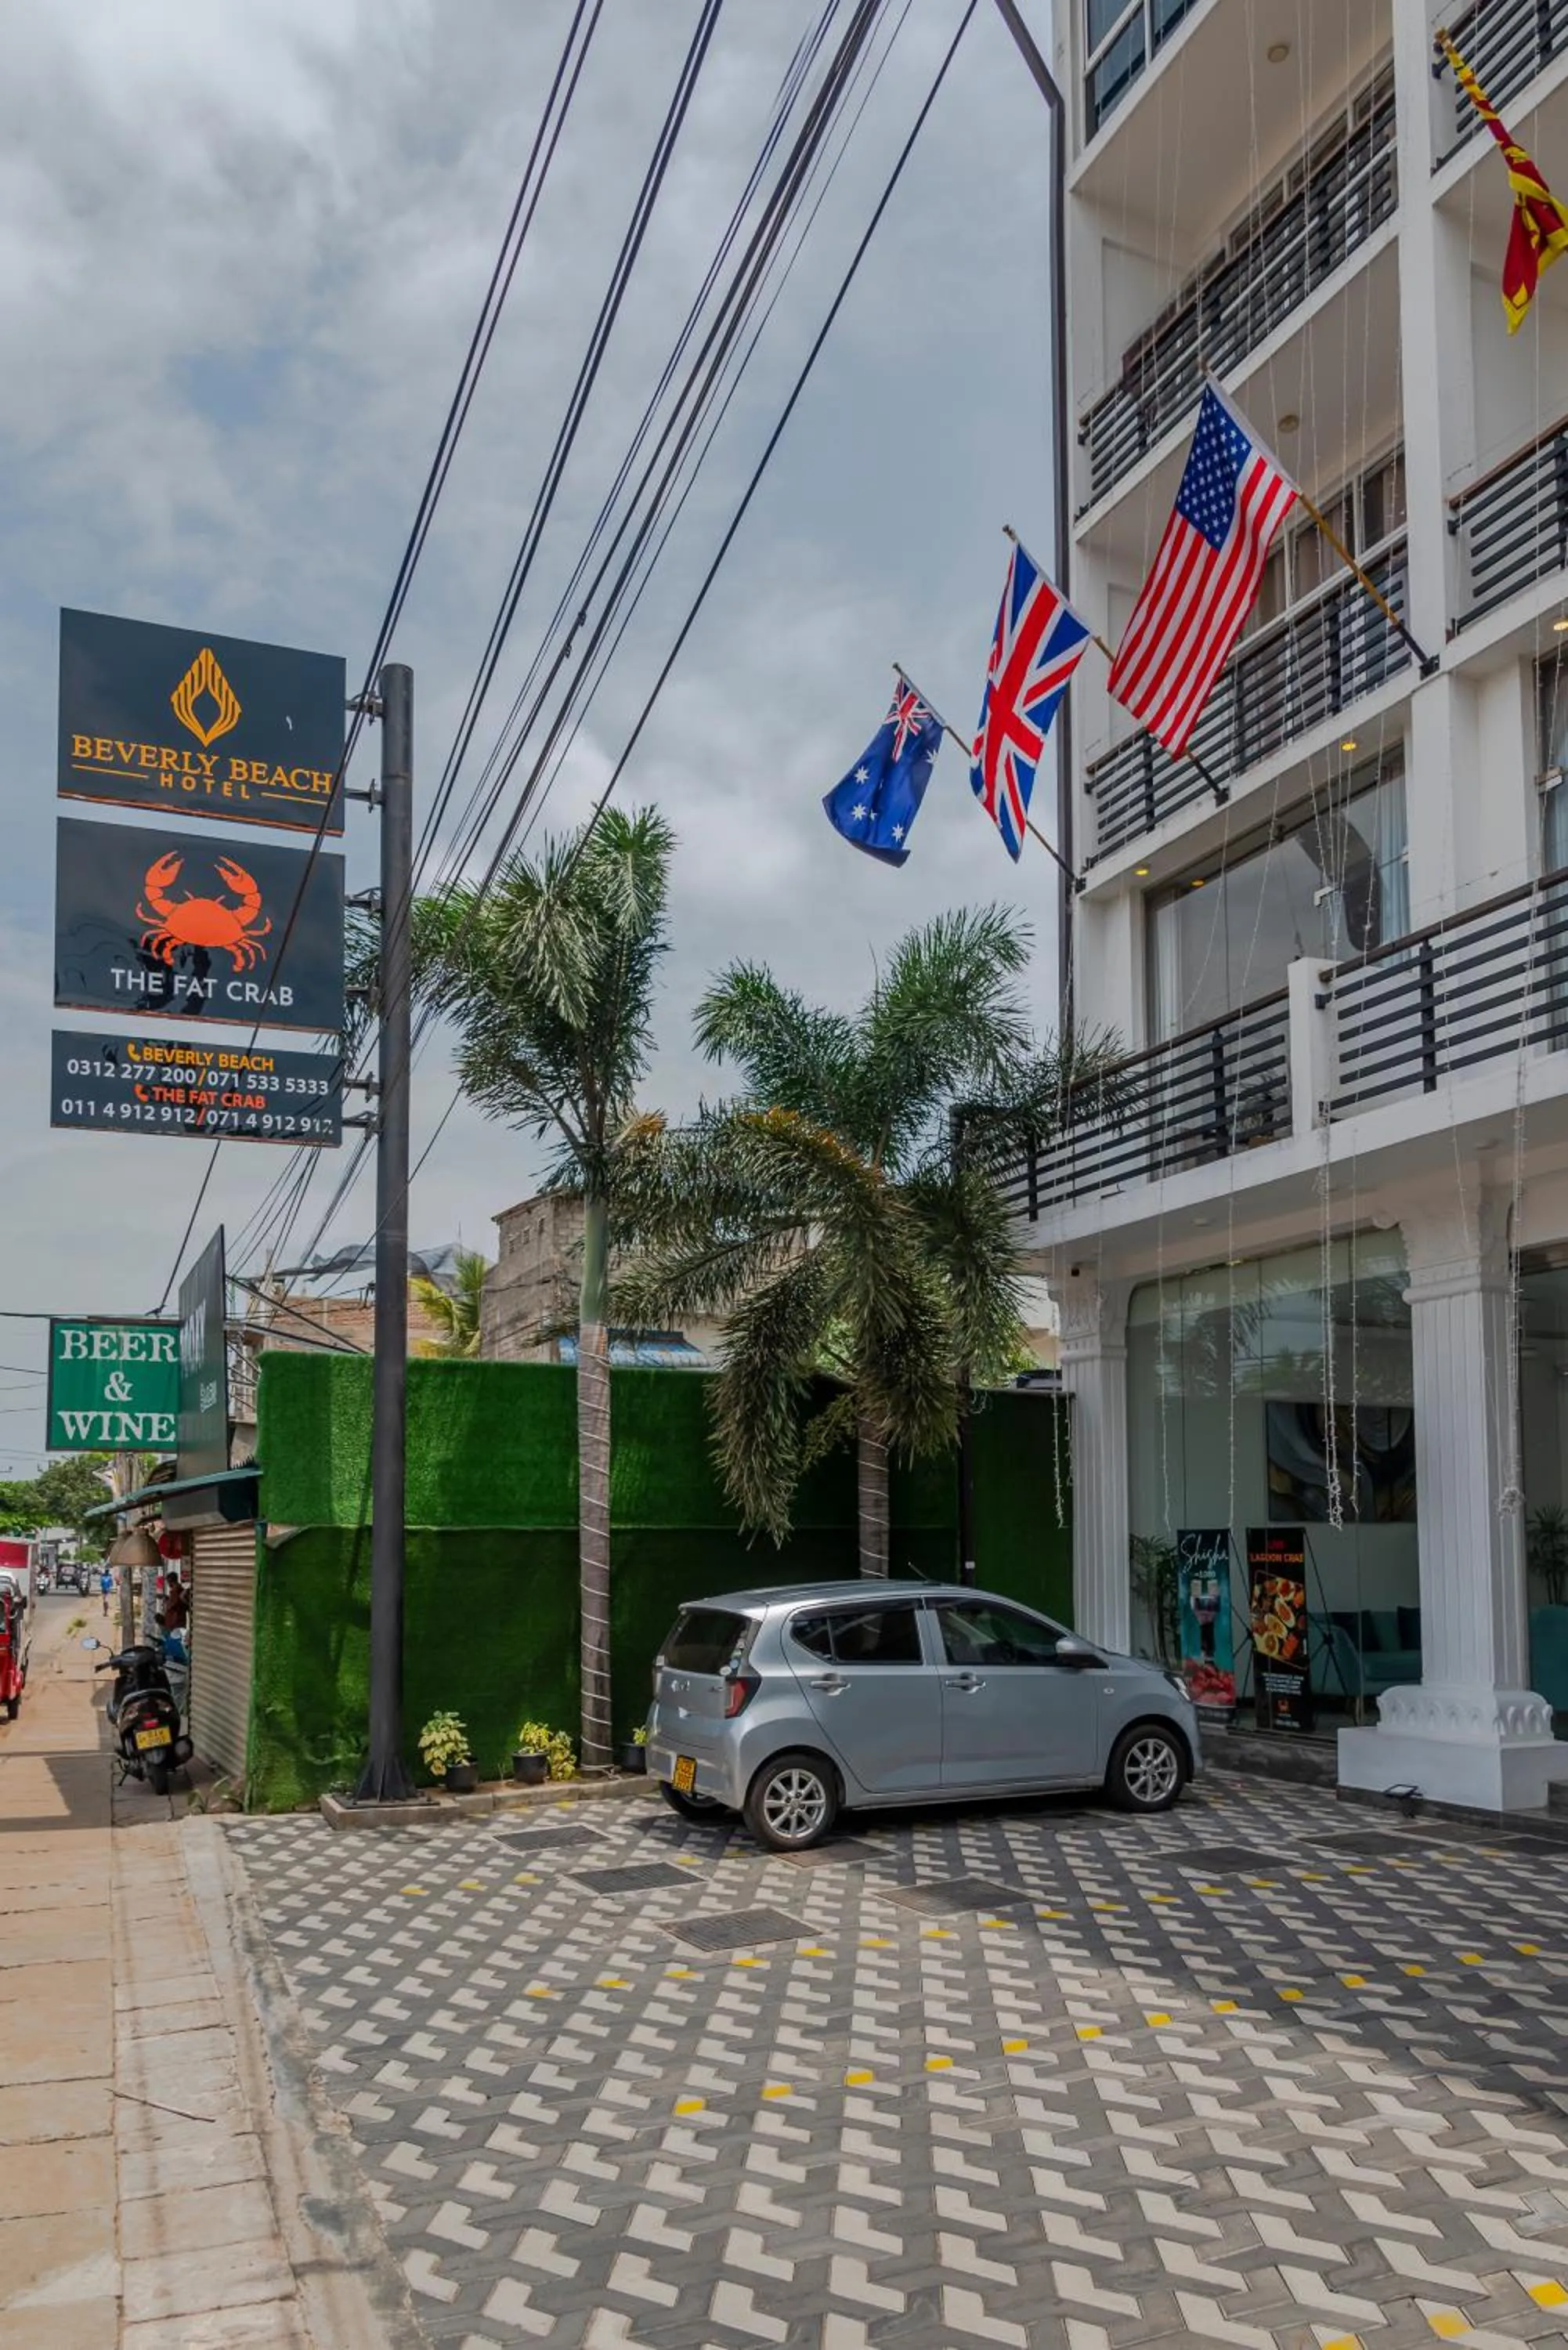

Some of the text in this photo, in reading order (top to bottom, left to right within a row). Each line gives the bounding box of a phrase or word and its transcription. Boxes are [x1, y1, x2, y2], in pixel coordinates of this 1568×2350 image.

[71, 734, 332, 794] BEVERLY BEACH
[160, 772, 251, 799] HOTEL
[110, 968, 293, 1007] THE FAT CRAB
[143, 1047, 273, 1072] BEVERLY BEACH
[67, 1059, 115, 1078] 0312
[121, 1064, 155, 1080] 277
[247, 1075, 280, 1091] 533
[285, 1078, 328, 1096] 5333
[152, 1086, 266, 1110] THE FAT CRAB
[61, 1099, 95, 1116] 011
[103, 1102, 115, 1118] 4
[120, 1103, 156, 1120] 912
[245, 1113, 258, 1128] 4
[262, 1114, 295, 1131] 912
[59, 1329, 179, 1362] BEER
[104, 1372, 133, 1401] &
[57, 1411, 176, 1442] WINE
